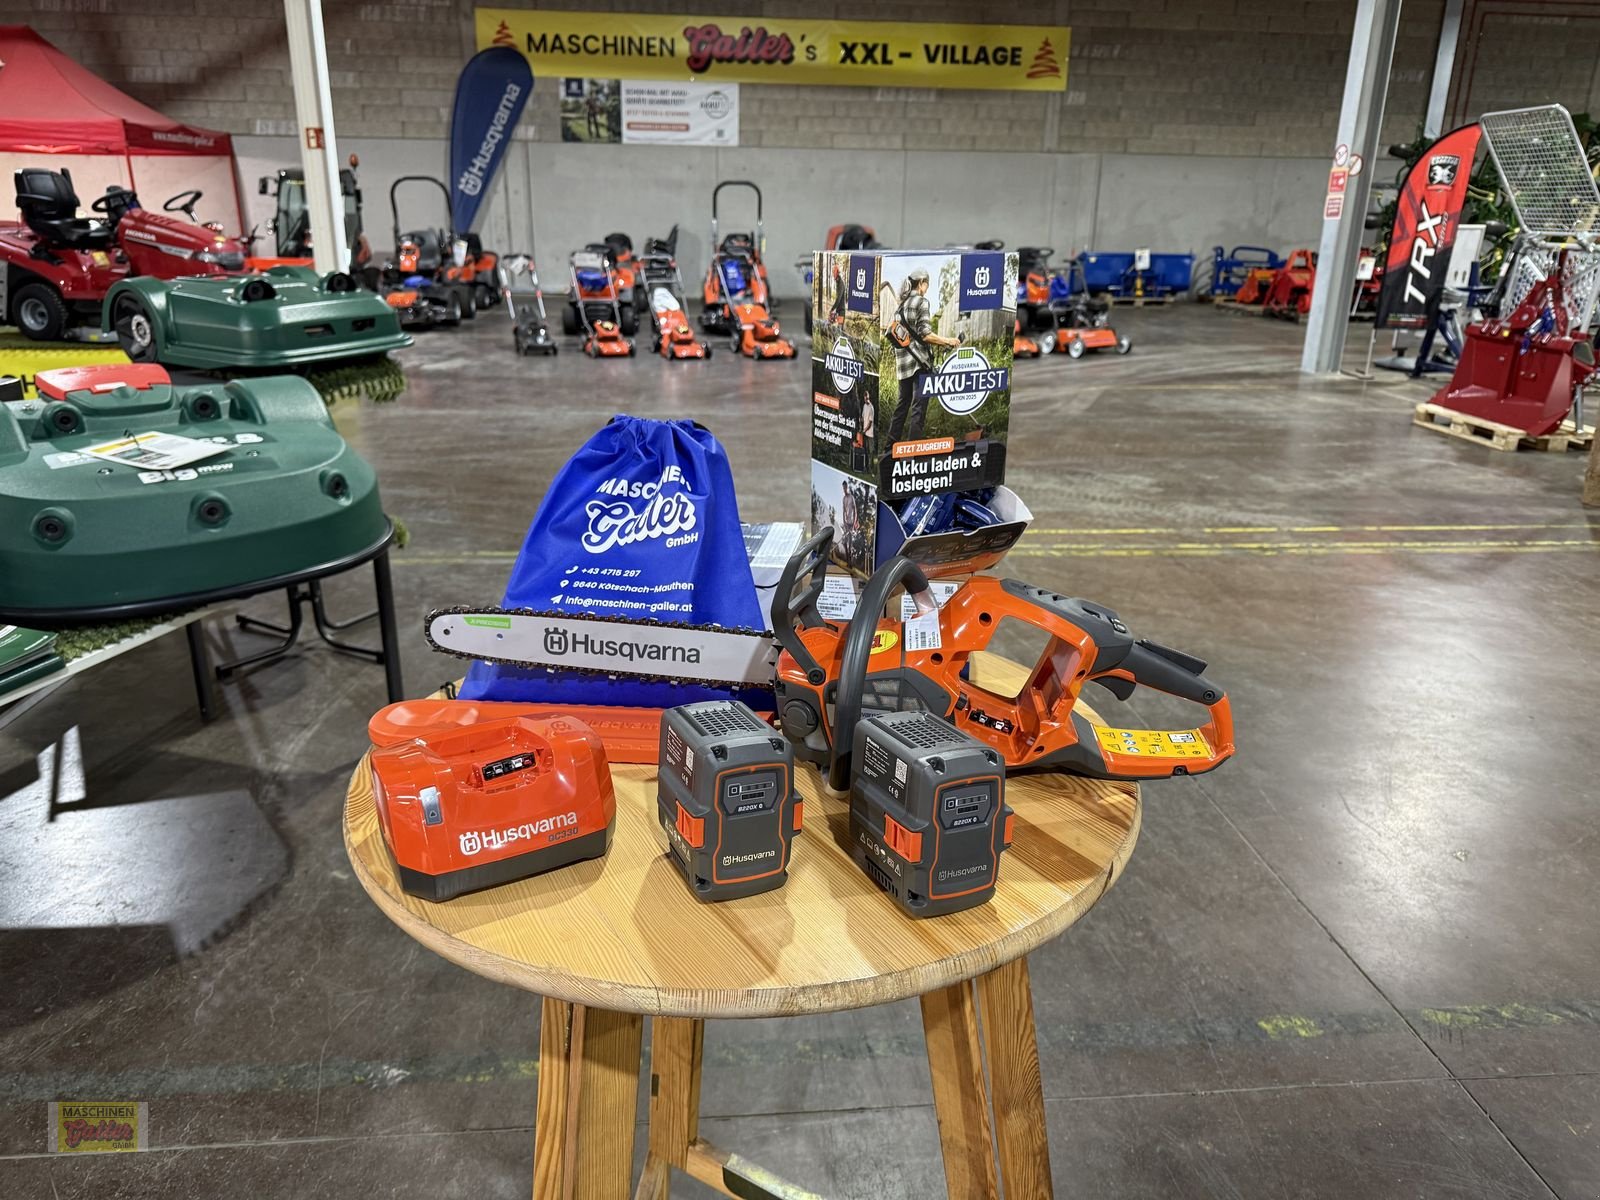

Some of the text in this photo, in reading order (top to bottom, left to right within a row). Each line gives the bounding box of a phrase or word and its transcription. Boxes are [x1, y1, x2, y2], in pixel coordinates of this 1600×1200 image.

[527, 33, 676, 57] MASCHINEN
[924, 44, 1023, 66] VILLAGE
[468, 83, 521, 176] Husqvarna
[124, 229, 157, 241] HONDA
[1404, 201, 1442, 304] TRX
[967, 288, 997, 297] Husqvarna
[825, 354, 863, 378] AKKU-TEST
[951, 362, 980, 370] HUSQVARNA
[922, 370, 1005, 395] AKKU-TEST
[896, 441, 951, 454] JETZT ZUGREIFEN
[892, 452, 982, 477] Akku laden &
[892, 472, 953, 493] loslegen!
[665, 532, 699, 548] GmbH
[600, 569, 622, 577] 4715
[572, 581, 695, 593] 9640 Kötschach-Mauthen
[565, 595, 693, 612] info@maschinen-gailer.at
[571, 632, 701, 664] Husqvarna
[482, 811, 578, 848] Husqvarna
[732, 850, 776, 864] Husqvarna
[947, 864, 988, 879] Husqvarna
